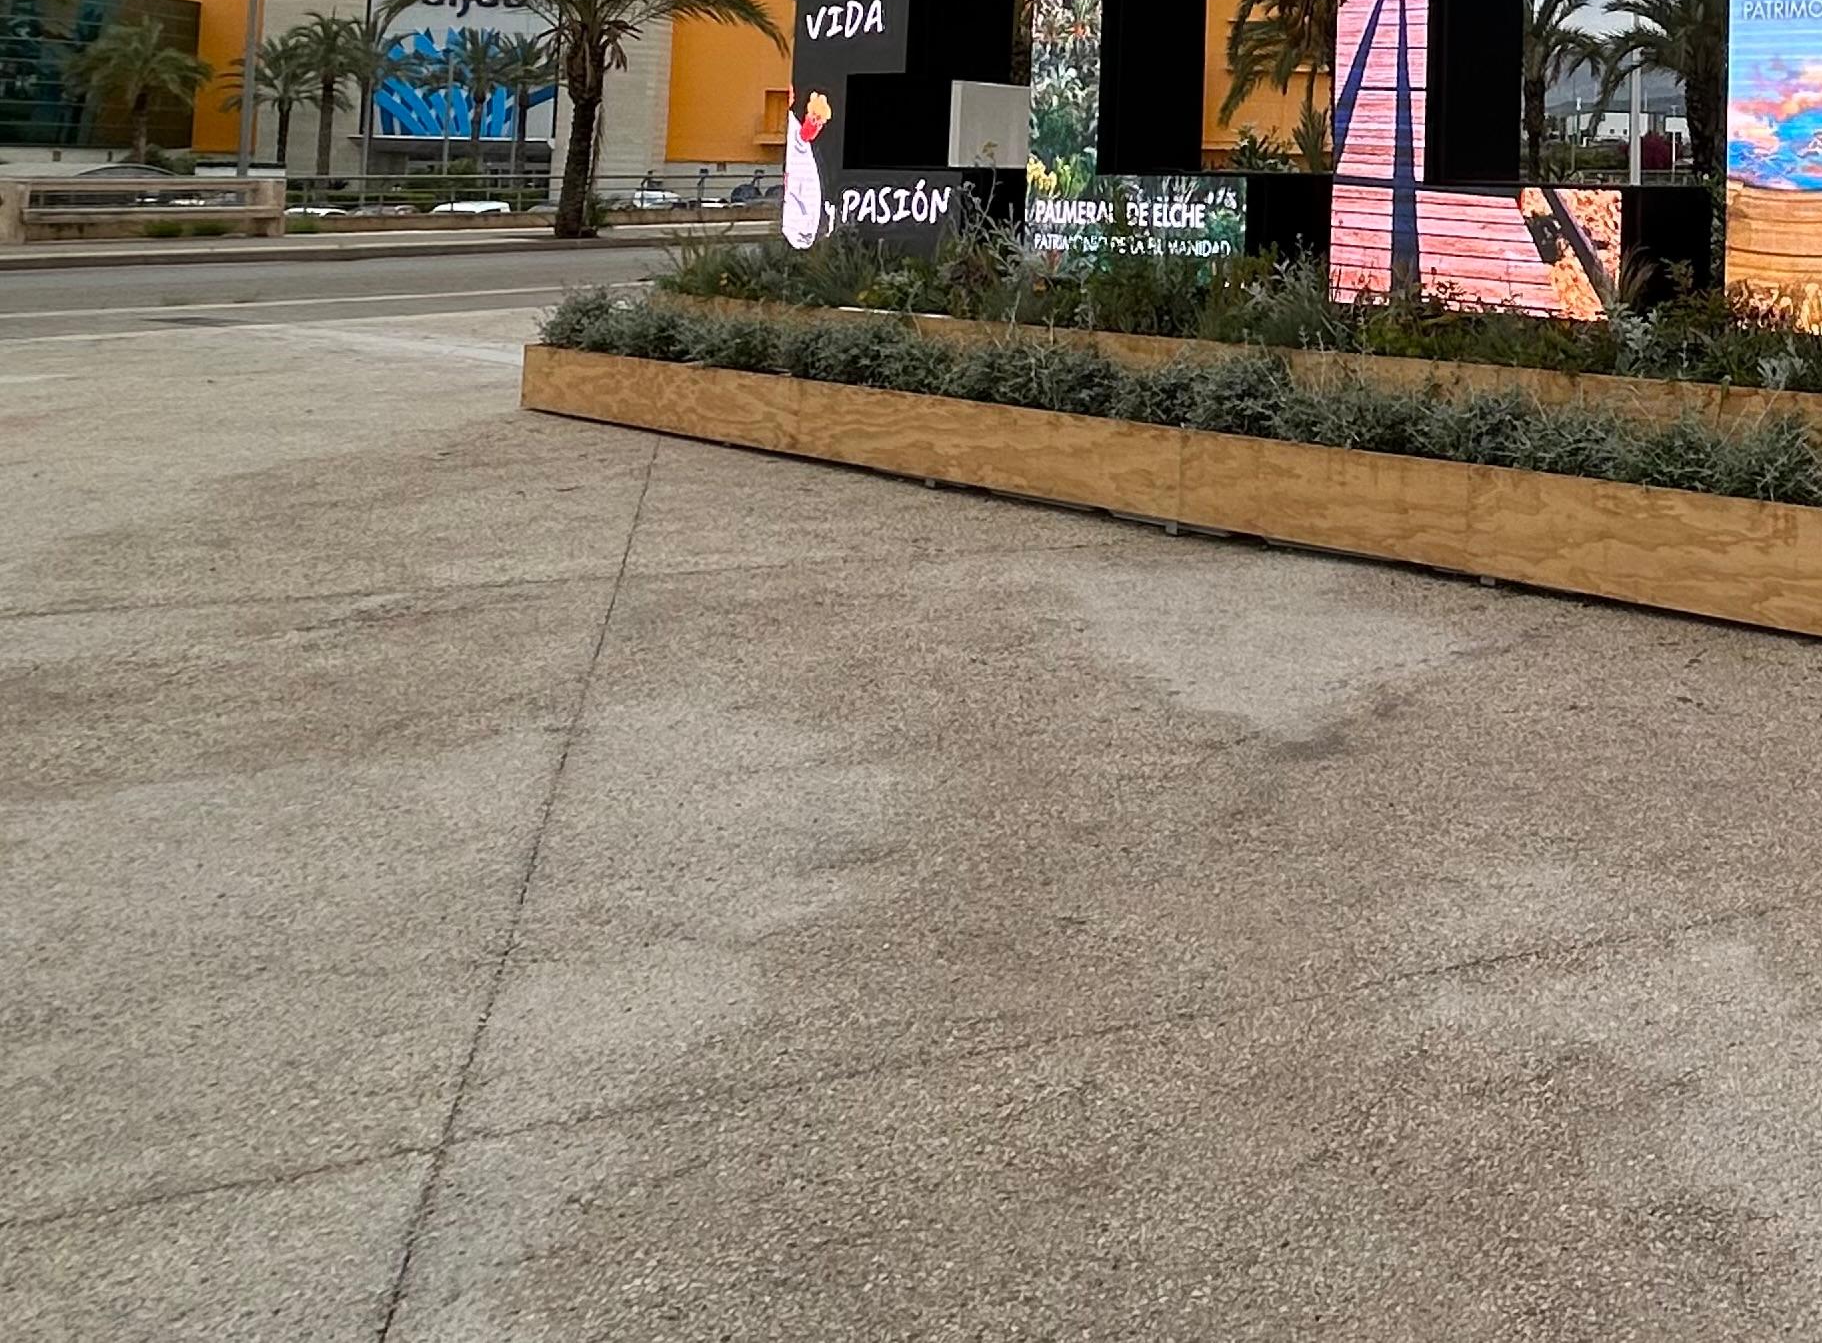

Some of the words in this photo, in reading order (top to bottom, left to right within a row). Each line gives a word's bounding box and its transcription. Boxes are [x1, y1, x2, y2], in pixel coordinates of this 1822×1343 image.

[806, 0, 885, 39] VIDA
[841, 178, 951, 225] PASIÓN
[1126, 202, 1148, 227] DE
[1153, 203, 1206, 229] ELCHE
